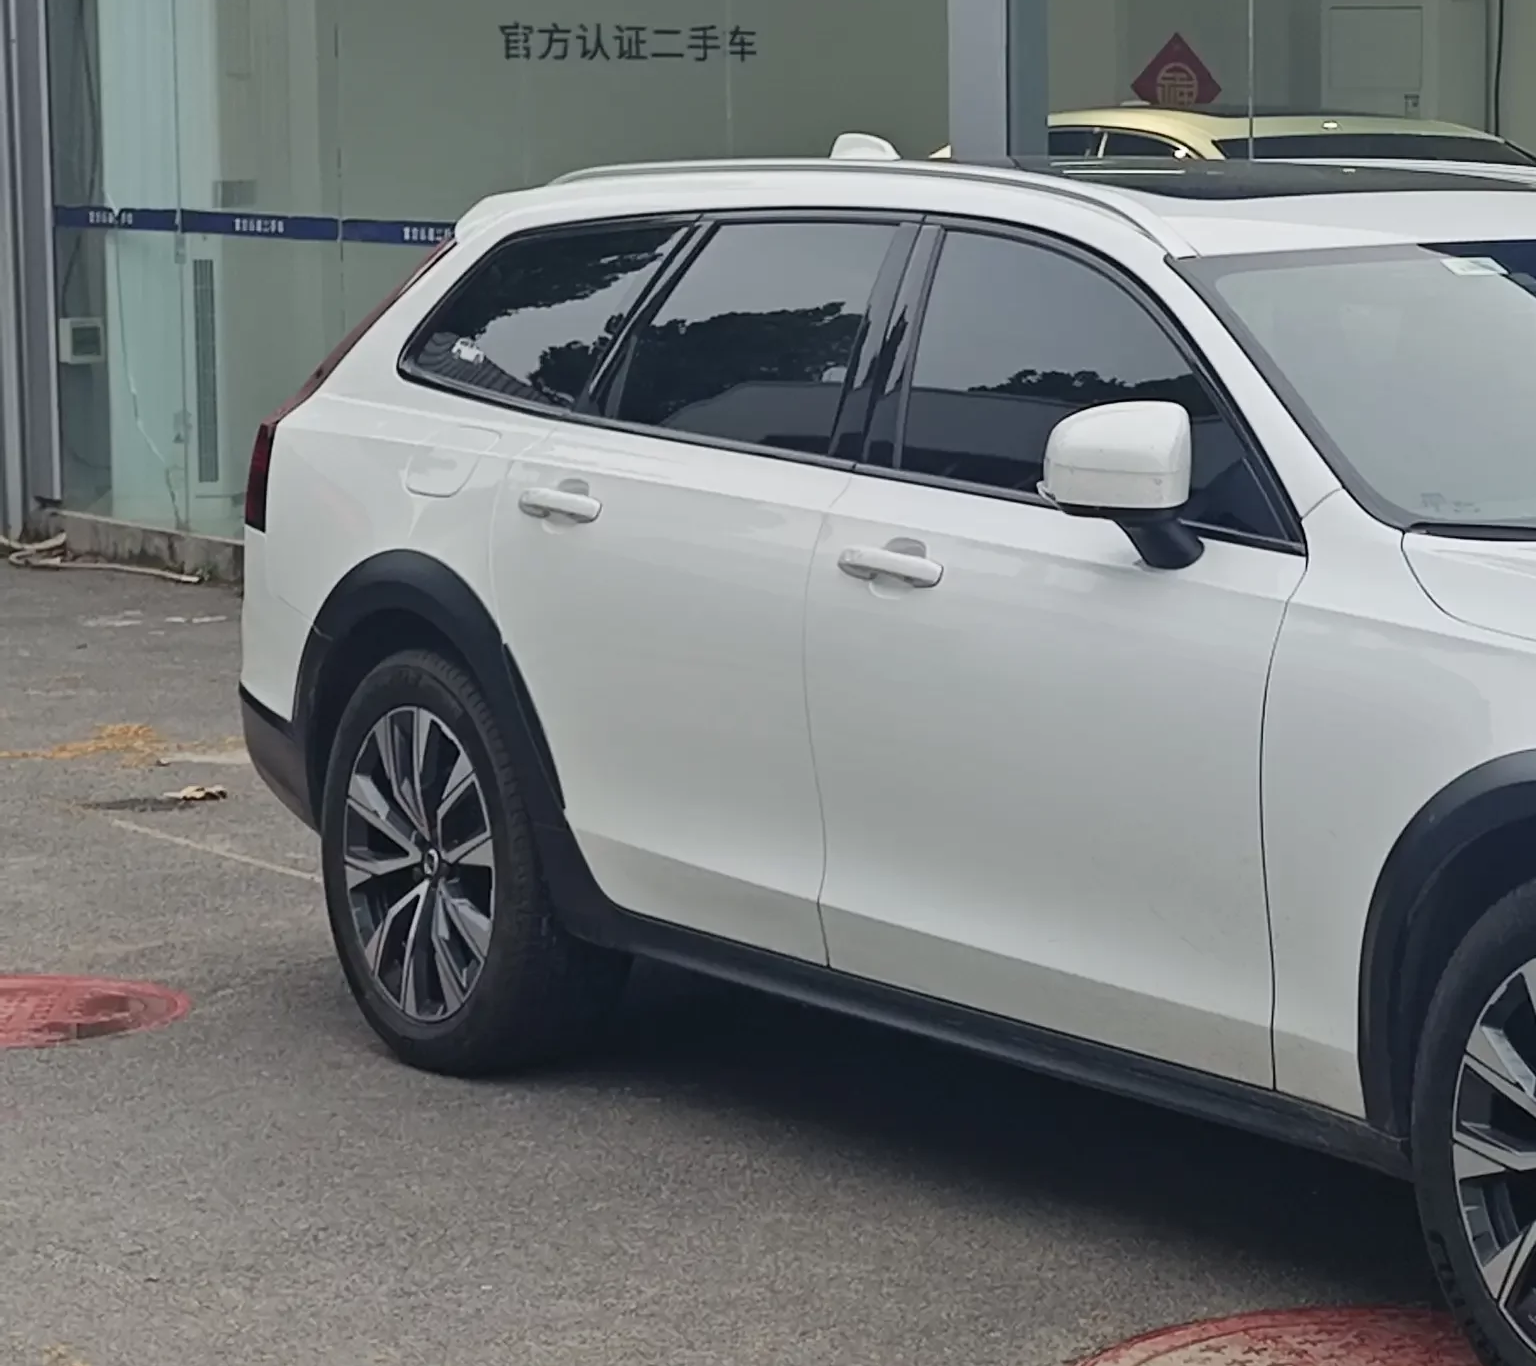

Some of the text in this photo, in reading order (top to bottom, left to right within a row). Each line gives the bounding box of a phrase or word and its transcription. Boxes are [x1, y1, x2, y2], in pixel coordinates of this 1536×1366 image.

[499, 21, 757, 62] 官方认证二手车
